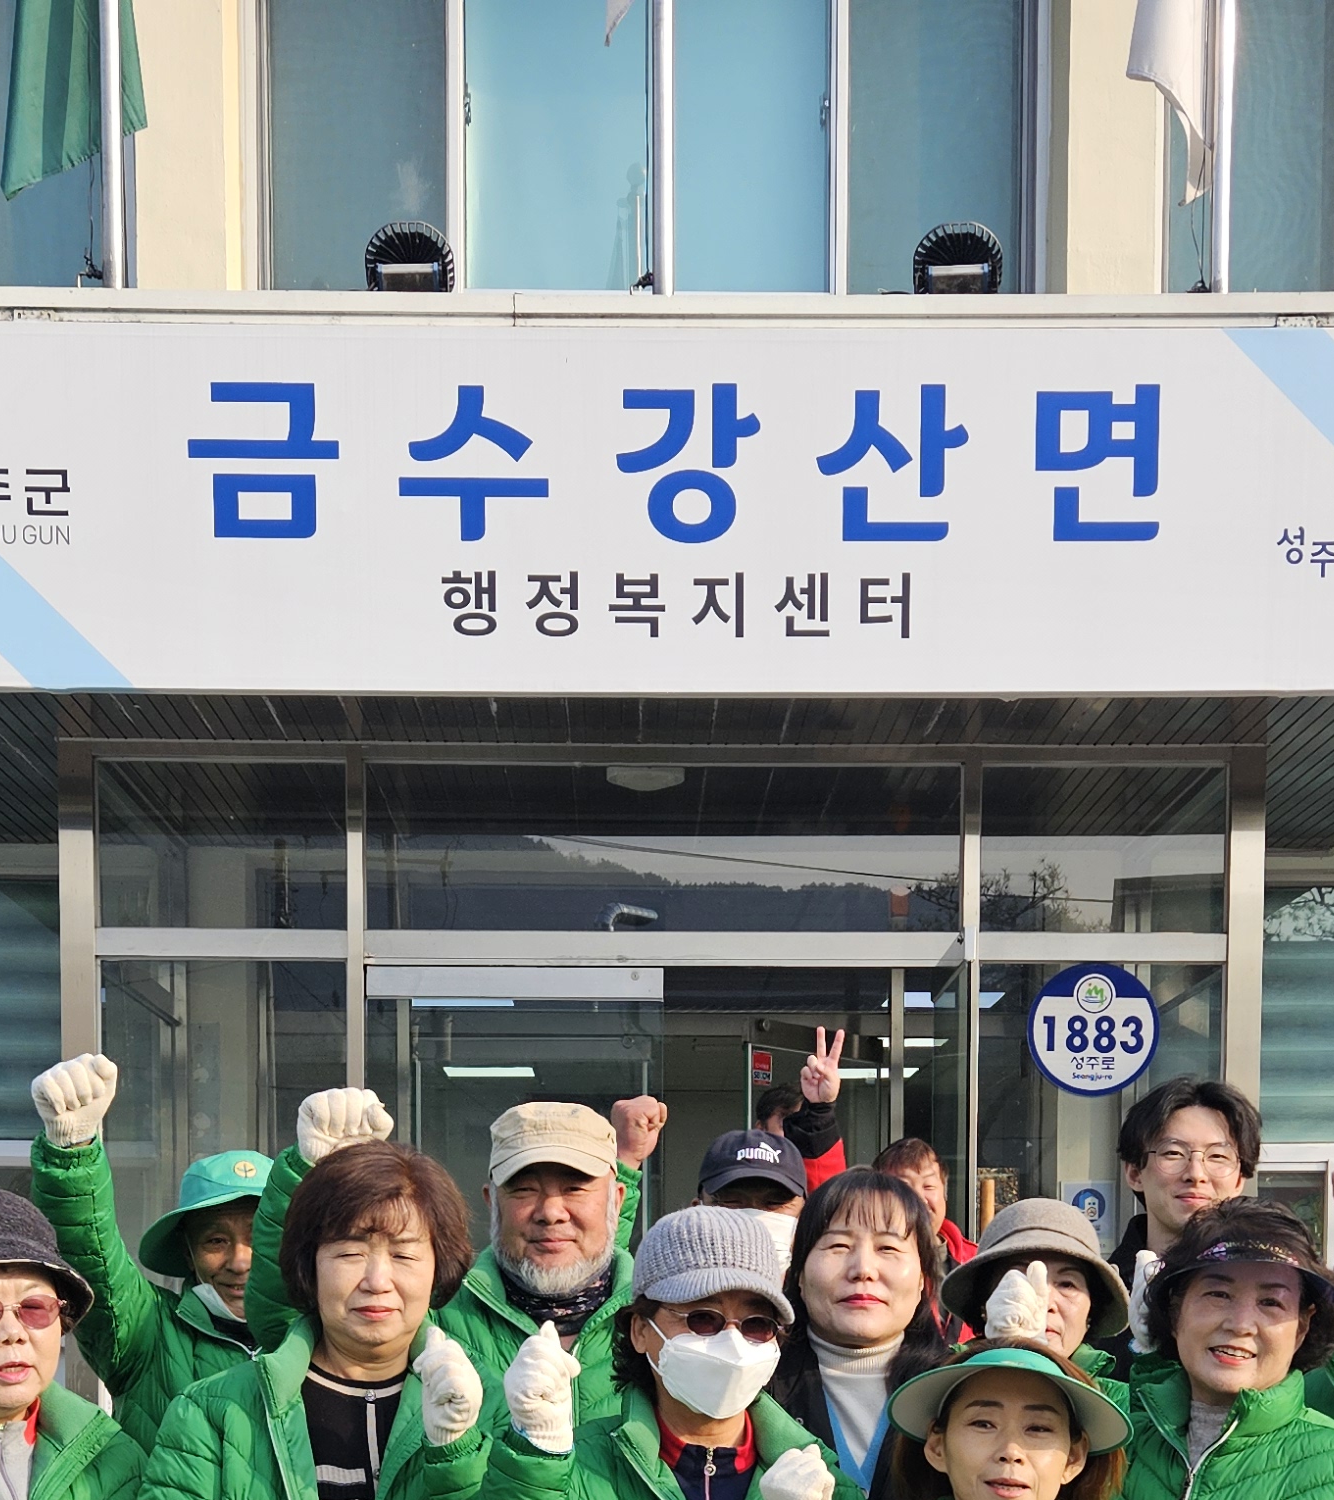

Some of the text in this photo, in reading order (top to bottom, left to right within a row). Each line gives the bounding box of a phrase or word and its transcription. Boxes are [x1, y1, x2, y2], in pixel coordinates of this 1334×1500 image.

[187, 381, 1162, 544] 금수강산면
[22, 524, 71, 545] GUN
[441, 569, 913, 639] 행정복지센터
[1043, 1015, 1144, 1054] 1883
[1069, 1056, 1115, 1070] 성주로
[1072, 1072, 1113, 1082] Seongju-ro
[736, 1147, 776, 1163] PUMA
